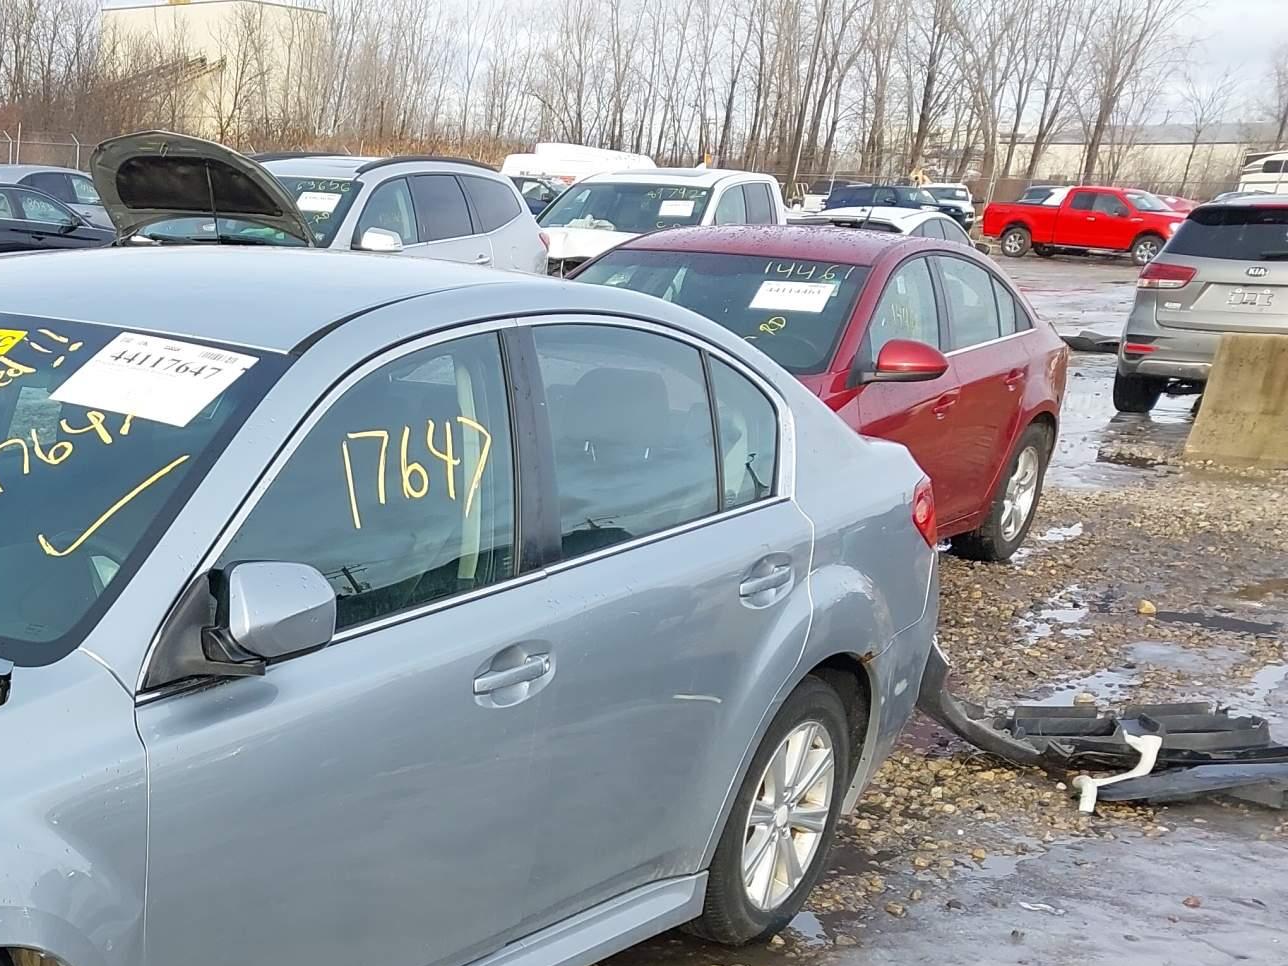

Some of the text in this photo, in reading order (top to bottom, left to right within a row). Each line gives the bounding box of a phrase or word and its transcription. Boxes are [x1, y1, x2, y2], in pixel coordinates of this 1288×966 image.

[764, 261, 856, 280] 14461
[1248, 267, 1266, 276] KIA
[110, 349, 222, 380] 44117647
[342, 416, 492, 529] 17647
